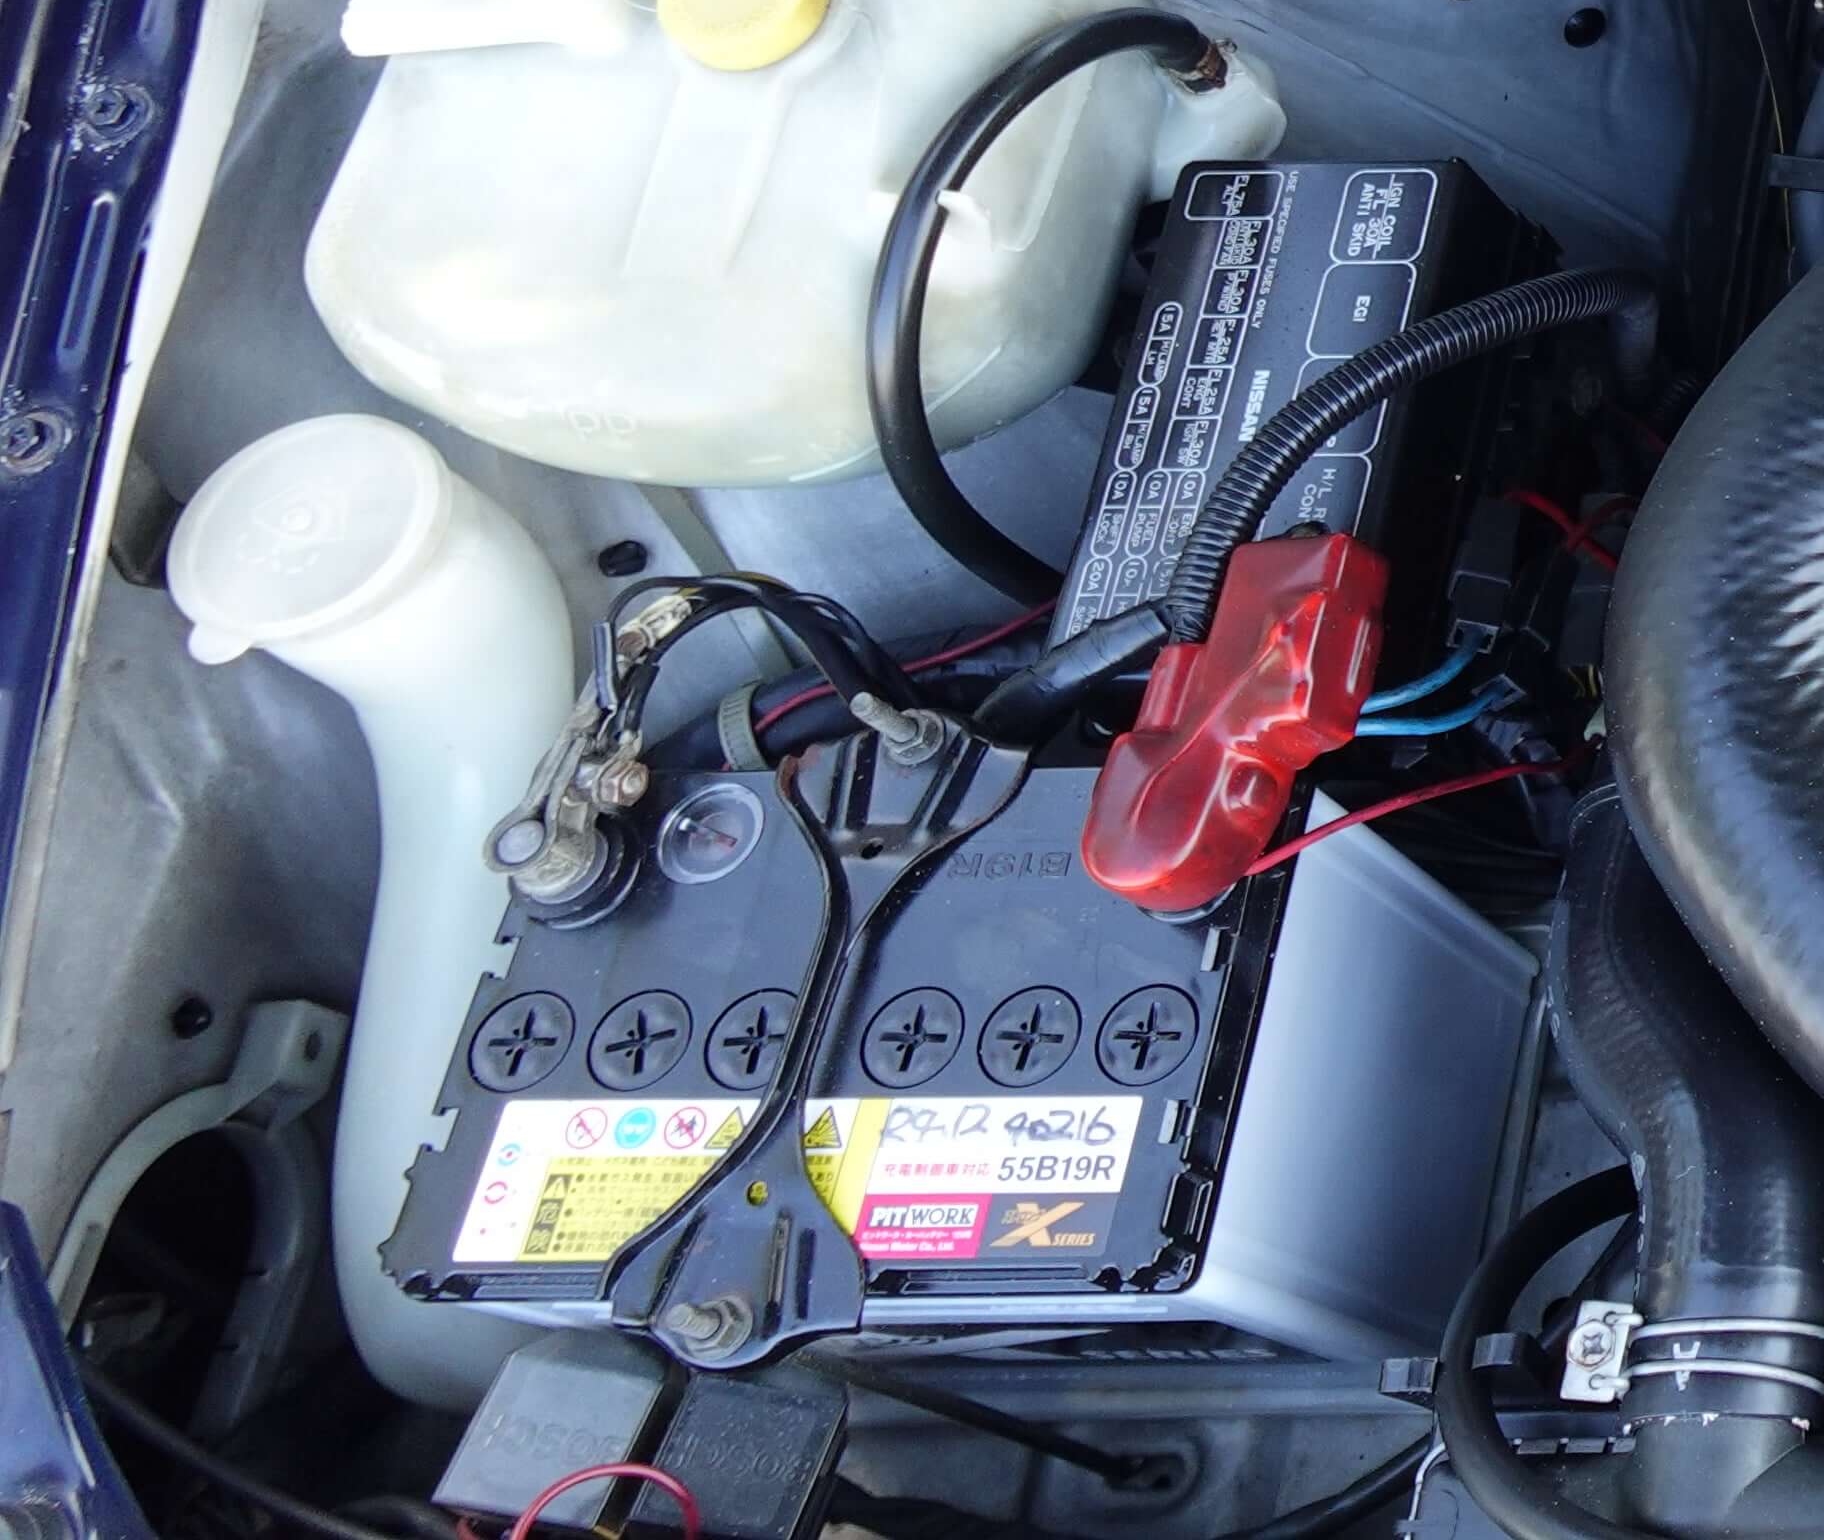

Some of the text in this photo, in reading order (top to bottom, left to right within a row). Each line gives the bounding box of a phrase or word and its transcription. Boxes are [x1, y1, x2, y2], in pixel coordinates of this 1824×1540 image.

[1346, 182, 1376, 258] ANTI SKID
[1380, 181, 1405, 247] IGN COIL
[1250, 170, 1299, 329] USE SPECIFIED FUSES ONLY
[1352, 294, 1372, 323] EGI
[1238, 369, 1271, 443] NISSAN
[1095, 511, 1112, 544] LOCK
[1105, 511, 1124, 546] SHIFT
[1129, 512, 1147, 549] PUMP
[1142, 511, 1159, 545] FUEL
[1086, 562, 1105, 592] 20A
[947, 851, 1072, 879] B19R
[996, 1155, 1116, 1181] 55B19R
[1053, 1232, 1096, 1247] SERIES
